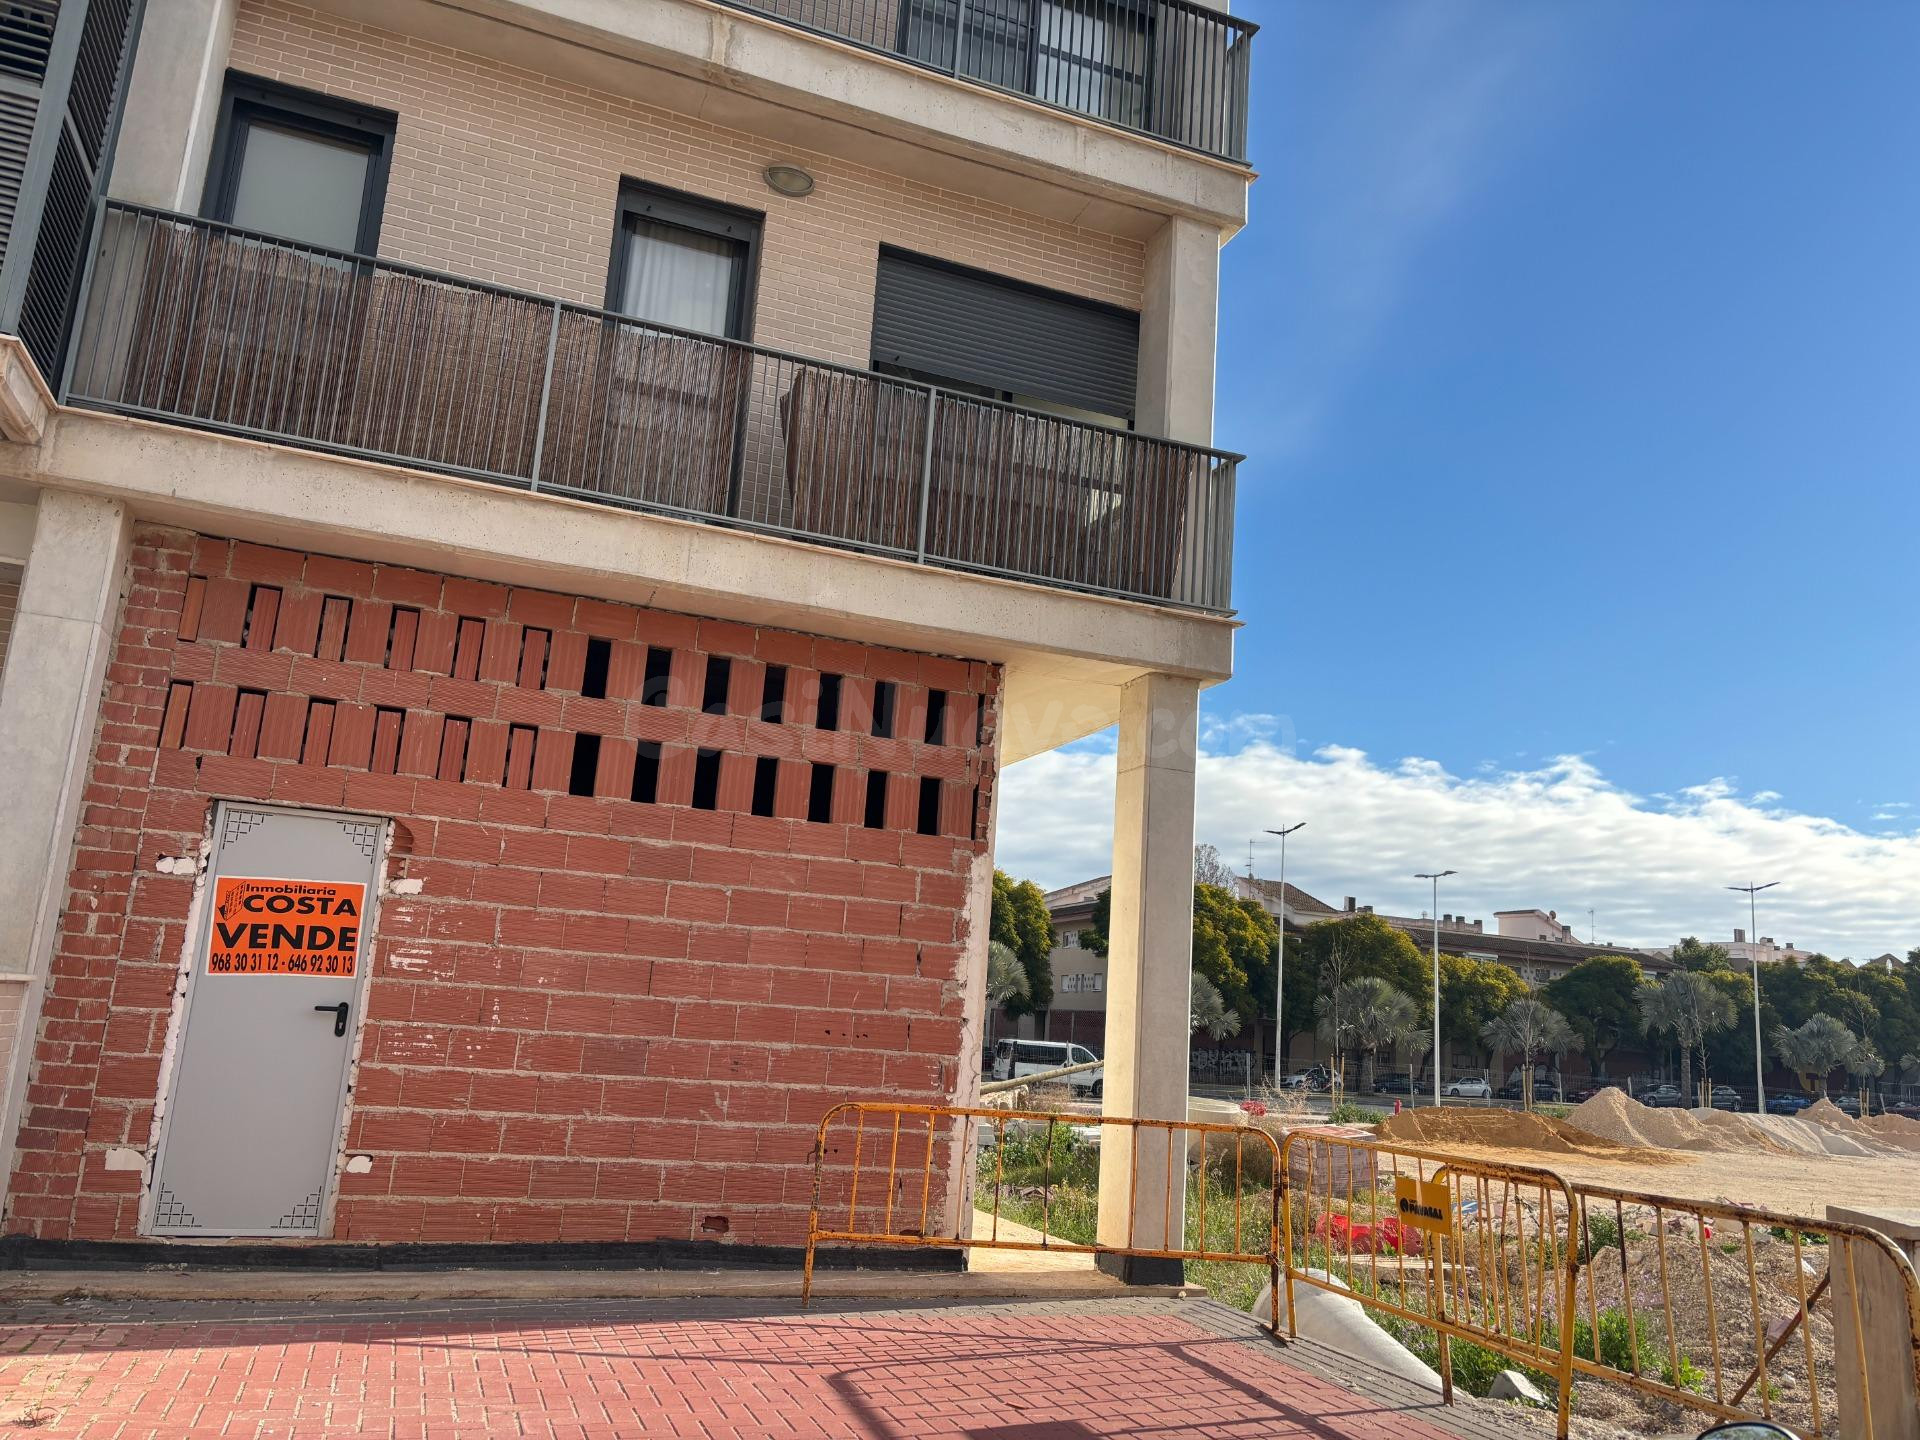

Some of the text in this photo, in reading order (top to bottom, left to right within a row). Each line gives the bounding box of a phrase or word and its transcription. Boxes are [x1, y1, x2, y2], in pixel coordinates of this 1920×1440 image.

[245, 883, 336, 896] Inmobiliaria
[244, 894, 357, 916] COSTA
[216, 922, 357, 952] VENDE
[212, 953, 231, 971] 968
[234, 953, 248, 971] 30
[250, 954, 262, 971] 31
[267, 954, 279, 971] 12
[288, 954, 308, 972] 646
[310, 955, 324, 972] 92
[325, 955, 339, 973] 30
[342, 956, 353, 973] 13
